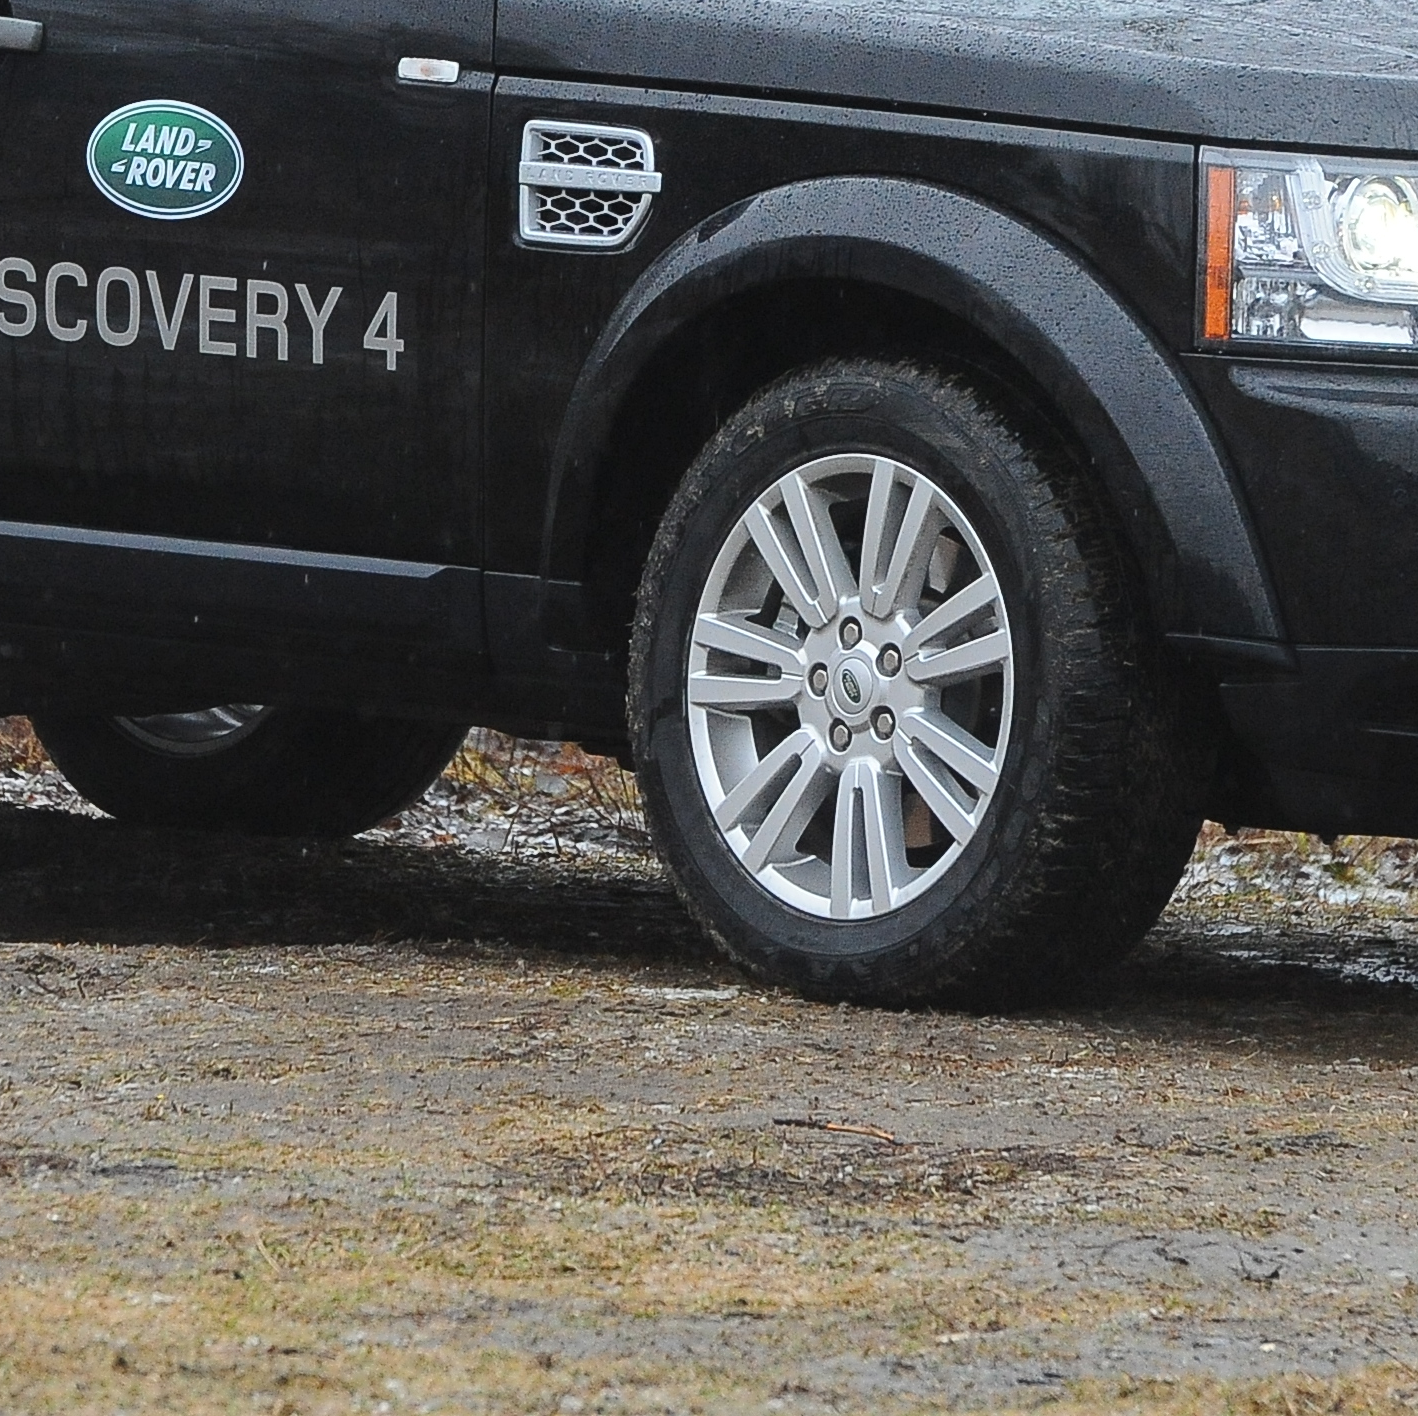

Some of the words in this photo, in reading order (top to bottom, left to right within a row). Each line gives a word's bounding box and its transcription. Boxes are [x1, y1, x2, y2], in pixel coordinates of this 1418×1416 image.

[121, 122, 196, 157] LAND
[125, 155, 217, 193] ROVER
[526, 166, 574, 183] LAND
[584, 170, 649, 188] ROVER
[363, 291, 405, 371] 4
